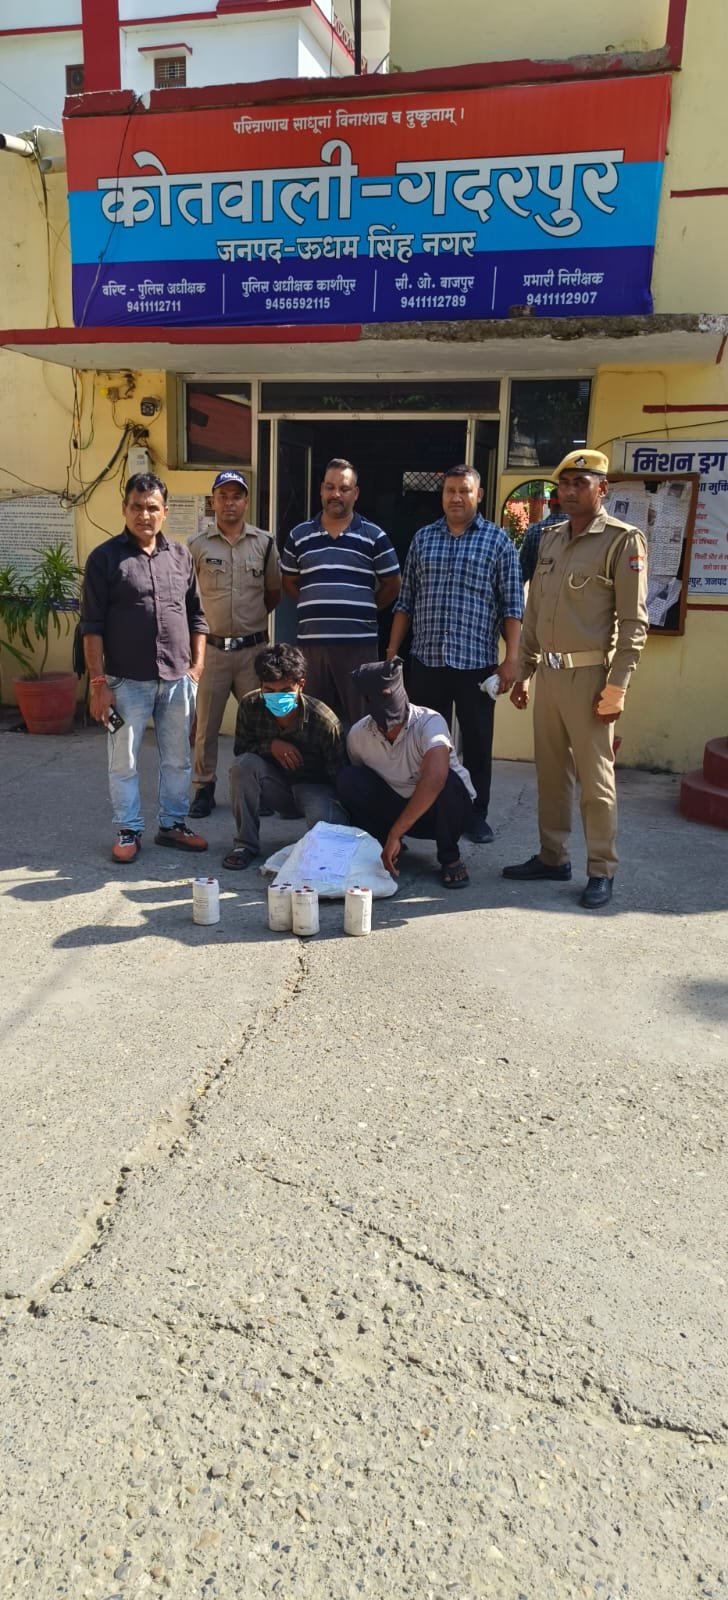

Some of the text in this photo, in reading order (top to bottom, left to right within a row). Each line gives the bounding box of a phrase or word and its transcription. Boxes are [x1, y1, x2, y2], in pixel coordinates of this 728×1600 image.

[293, 110, 332, 134] साधूनां
[336, 109, 388, 127] विनाशाय
[392, 111, 402, 124] च
[406, 108, 457, 128] दुष्कृताम्
[368, 224, 415, 263] सिंह
[422, 231, 477, 257] नगर
[242, 274, 356, 298] पुलिस अधीक्षक काशीपुर
[395, 273, 412, 291] सी.
[440, 276, 475, 293] बाजपुर
[523, 268, 605, 287] प्रभारी निरीक्षक
[138, 280, 164, 299] पुलिस
[167, 278, 206, 295] अधीक्षक
[127, 300, 181, 312] 9411112711
[265, 297, 331, 309] 9456592115
[400, 295, 467, 308] 9411112789
[526, 292, 598, 305] 9411112907
[632, 448, 696, 472] मिशन
[704, 577, 727, 586] जनपद
